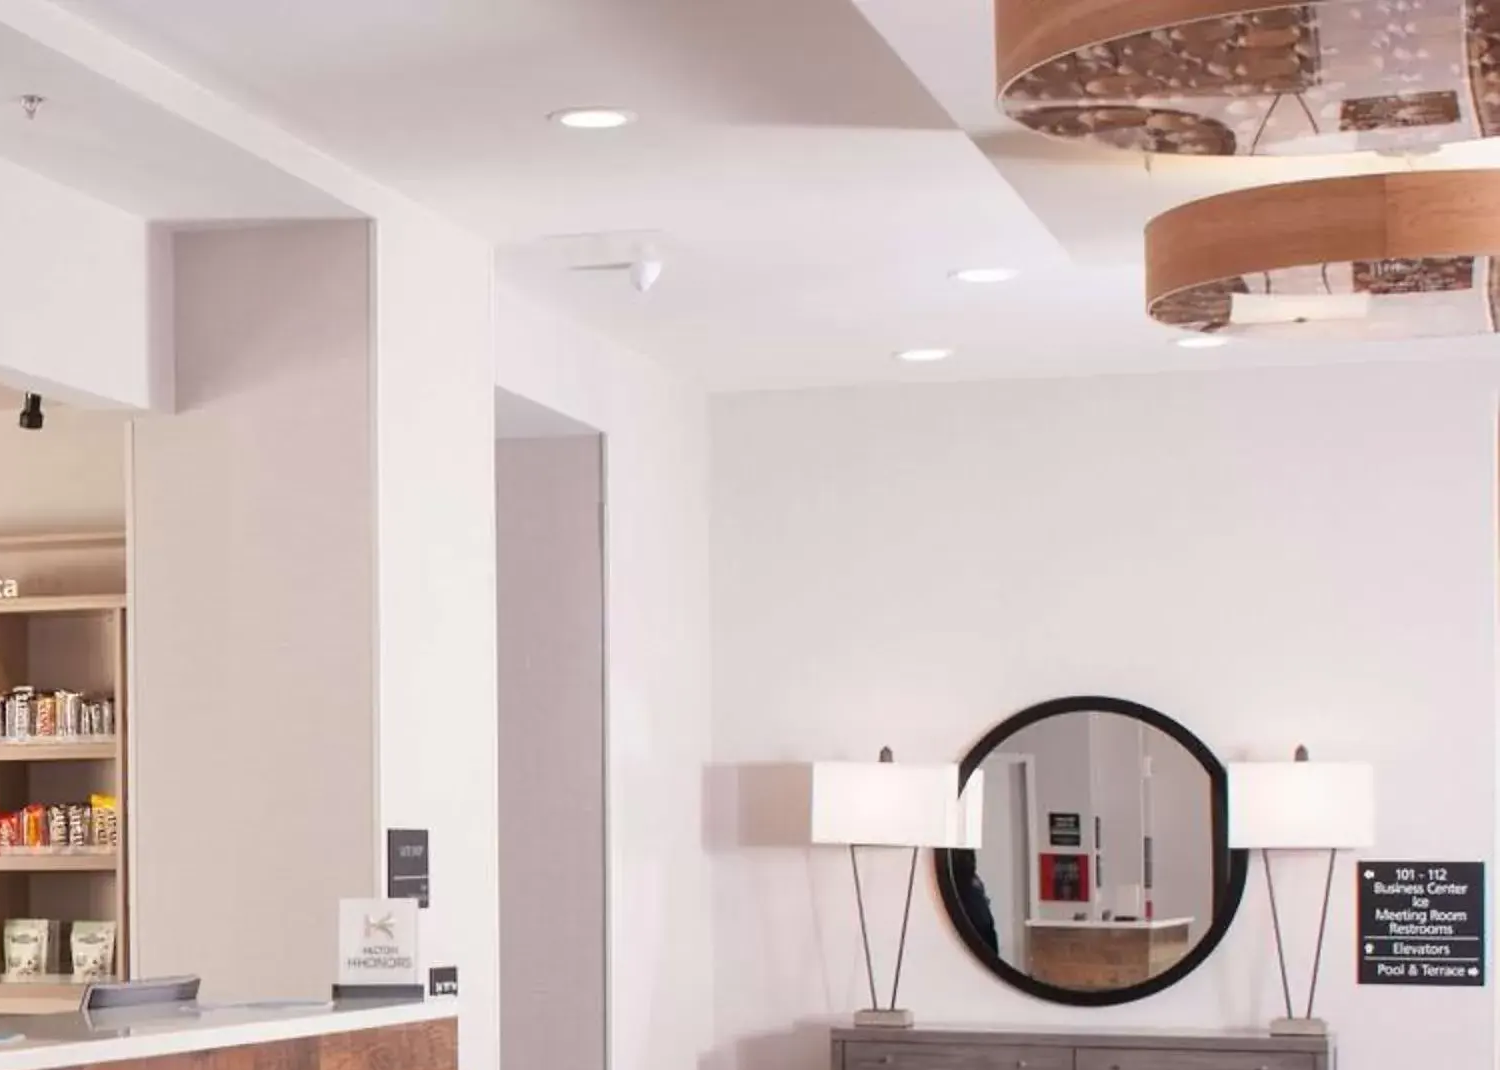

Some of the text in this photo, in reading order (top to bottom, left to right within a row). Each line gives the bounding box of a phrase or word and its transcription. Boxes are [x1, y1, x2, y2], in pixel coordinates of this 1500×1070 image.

[1395, 868, 1415, 881] 101
[1428, 868, 1448, 881] 112
[1373, 882, 1468, 895] Business Center
[1411, 896, 1430, 908] Ice
[1375, 909, 1467, 925] Meeting Room
[1389, 922, 1453, 935] Restrooms
[1393, 942, 1451, 955] Elevators
[1377, 964, 1405, 977] Pool
[1421, 964, 1466, 977] Terrace
